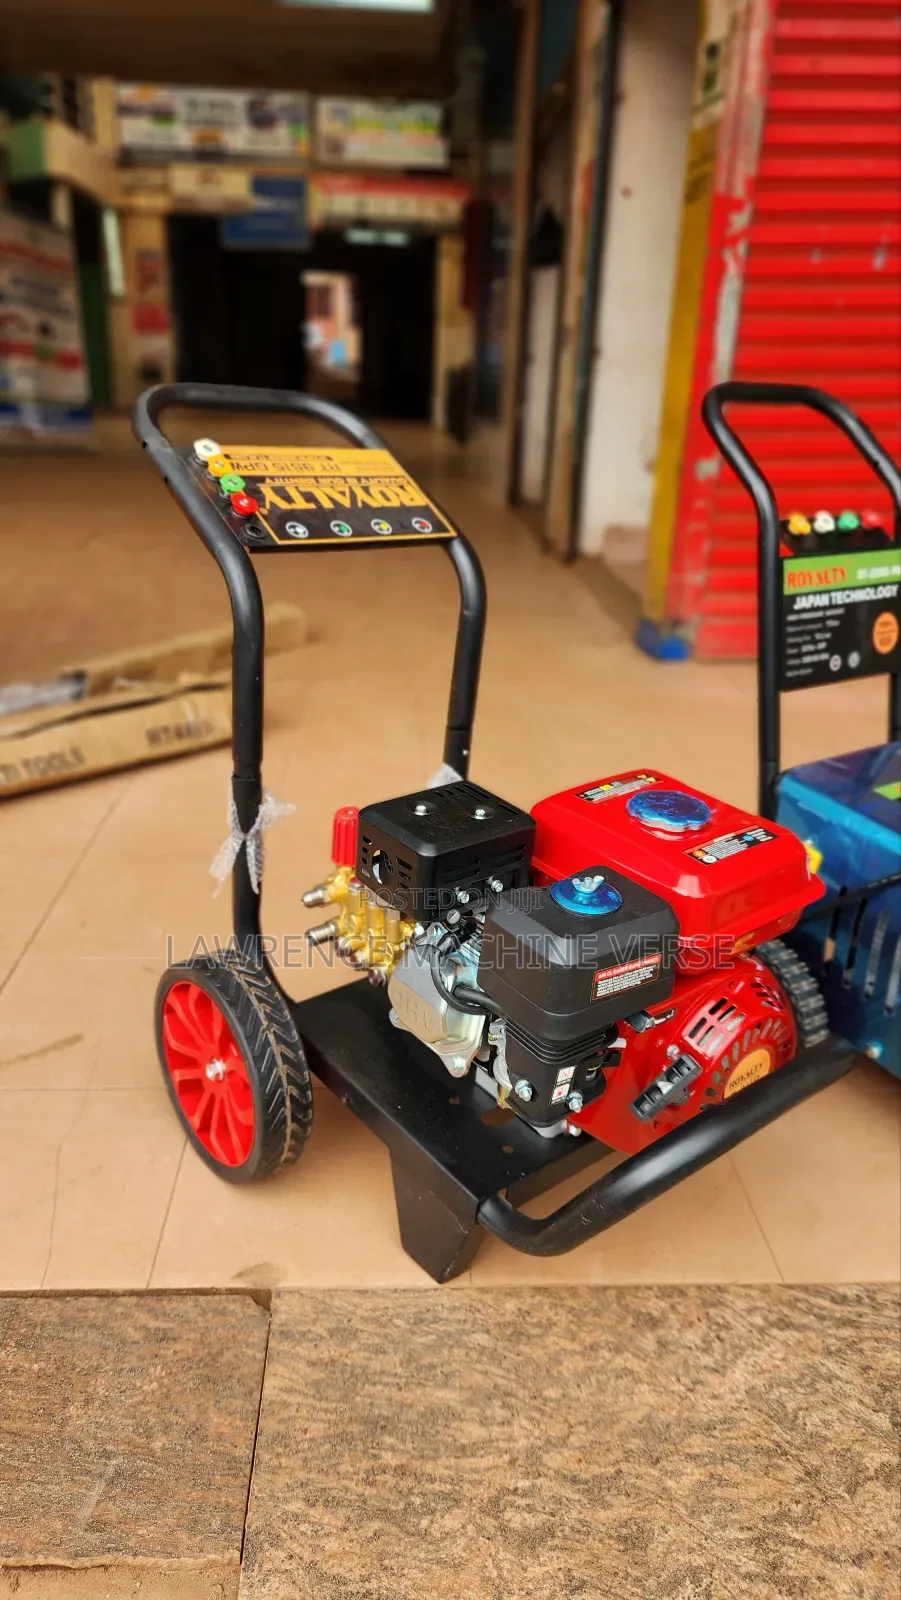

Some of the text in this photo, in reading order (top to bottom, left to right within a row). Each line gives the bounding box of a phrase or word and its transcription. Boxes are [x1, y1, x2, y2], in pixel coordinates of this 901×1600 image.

[259, 484, 428, 511] ROYALTY
[787, 567, 847, 589] ROYALTY
[793, 584, 898, 611] JAPAN TECHNOLOGY
[728, 1063, 763, 1089] ROYALTY
